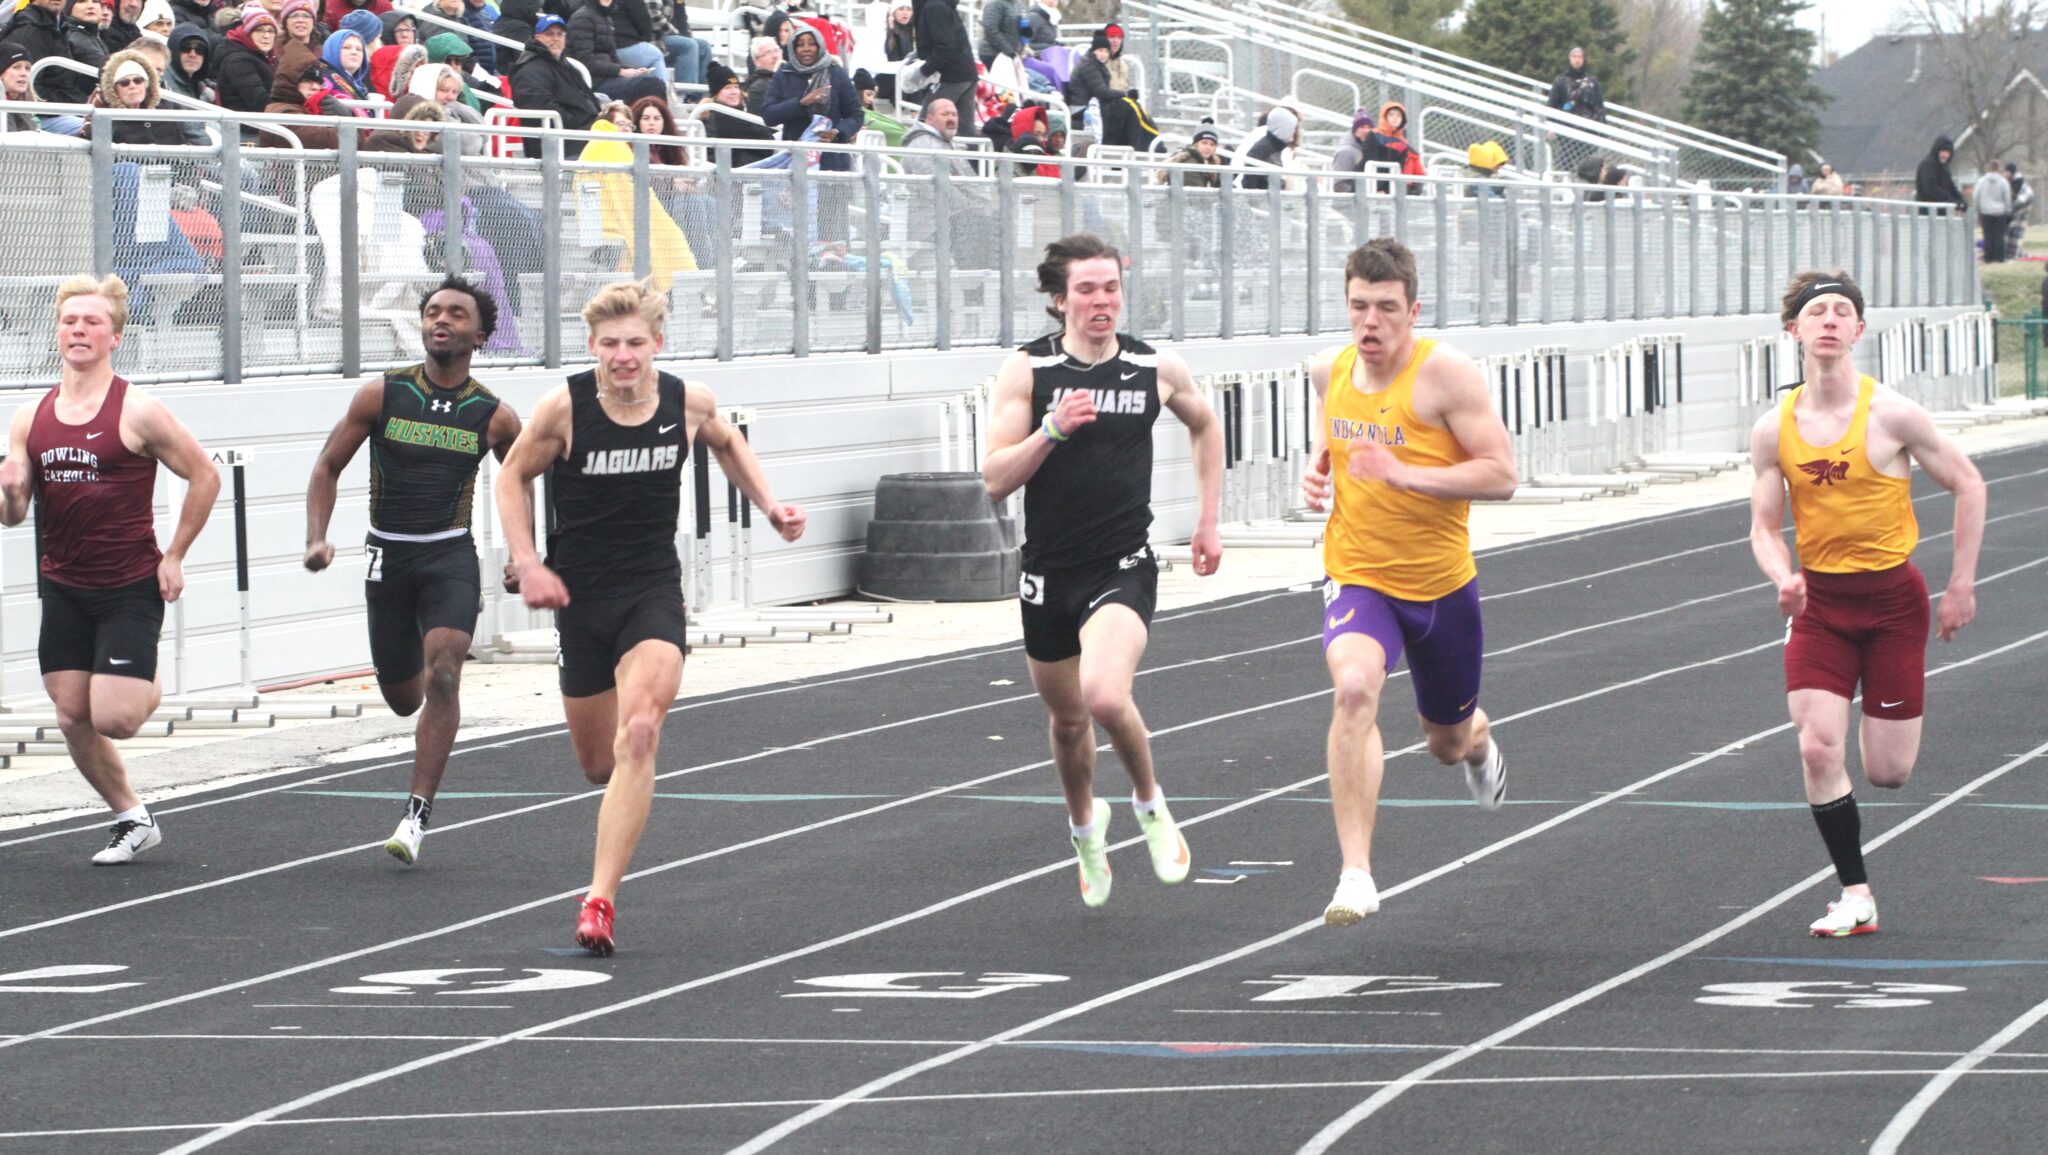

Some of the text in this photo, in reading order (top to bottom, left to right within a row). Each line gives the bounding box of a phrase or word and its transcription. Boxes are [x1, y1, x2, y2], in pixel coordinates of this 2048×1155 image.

[1046, 388, 1147, 414] JUARS
[384, 416, 479, 455] HUSKIES
[1329, 418, 1406, 446] NDIANOLA
[41, 447, 98, 468] DOWLING
[581, 444, 679, 475] JAGUARS
[44, 469, 100, 483] CATHOLIC
[367, 547, 379, 579] 7
[1023, 571, 1038, 601] 5
